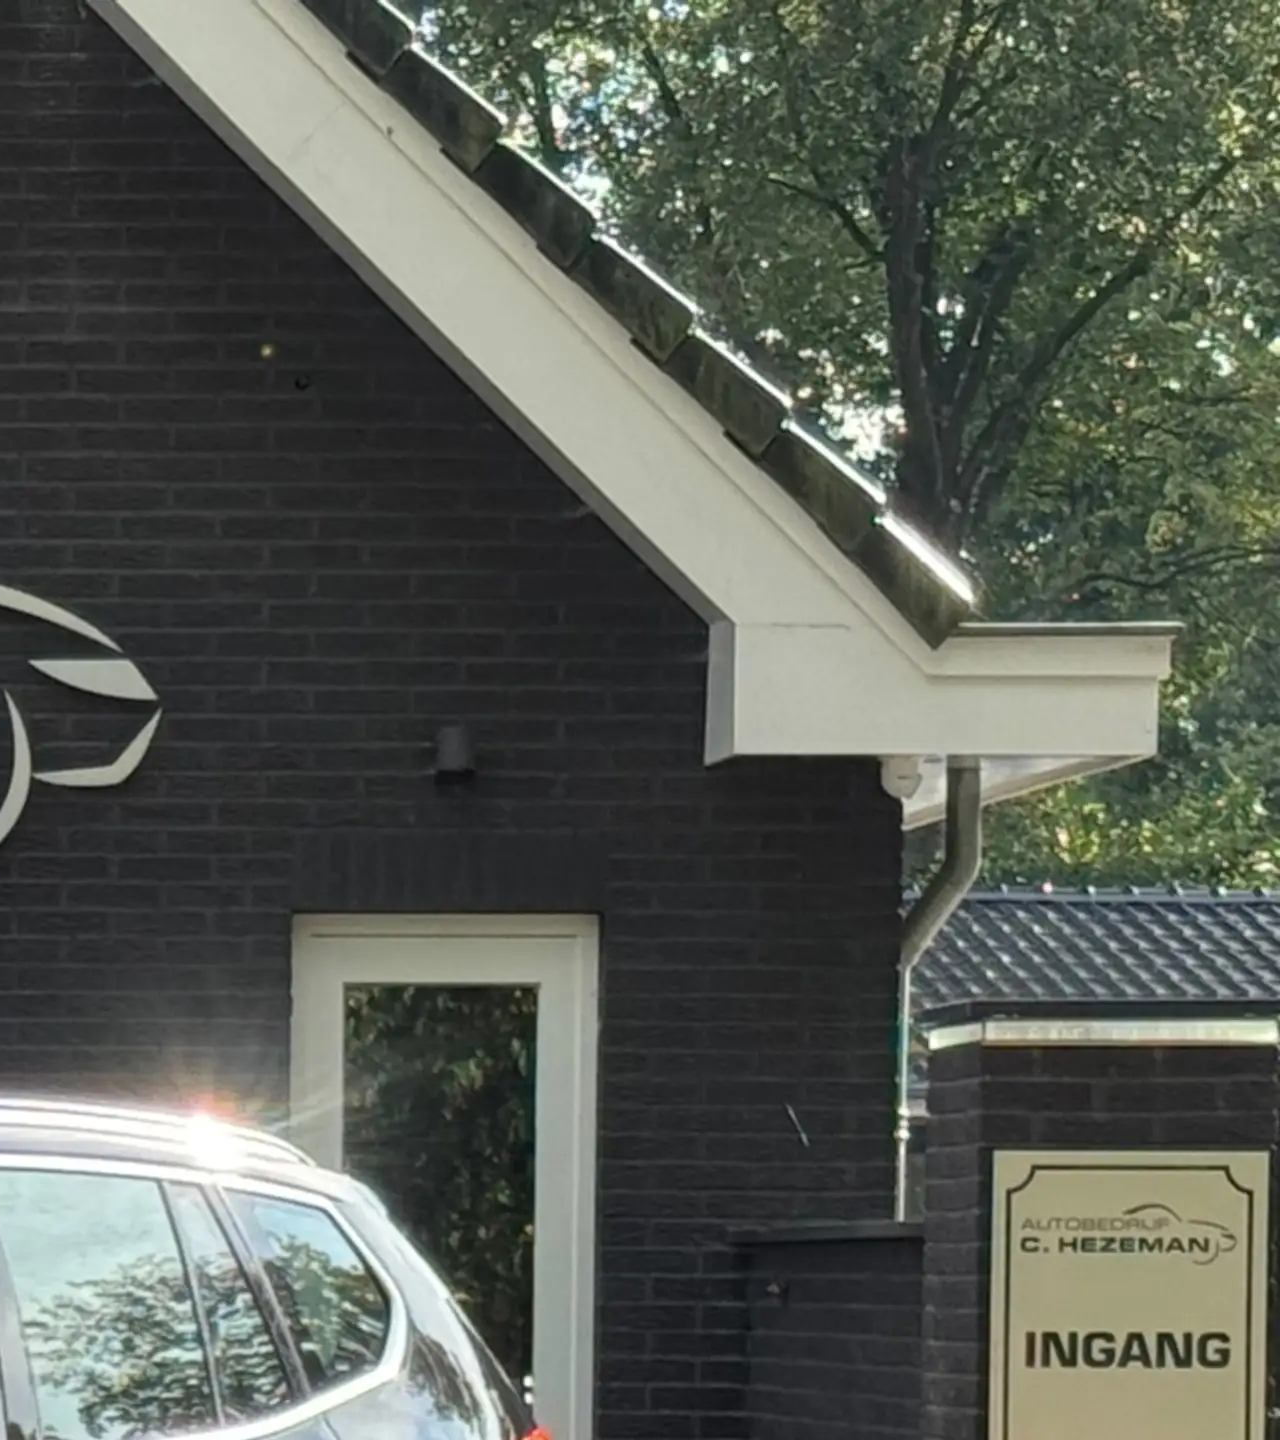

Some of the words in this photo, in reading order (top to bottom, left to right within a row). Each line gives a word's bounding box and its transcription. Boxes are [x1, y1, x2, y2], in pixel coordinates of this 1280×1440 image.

[1020, 1217, 1171, 1232] AUTOBEDRIJF
[1020, 1237, 1050, 1253] C.
[1058, 1237, 1210, 1254] HEZEMAN
[1024, 1331, 1232, 1369] INGANG
